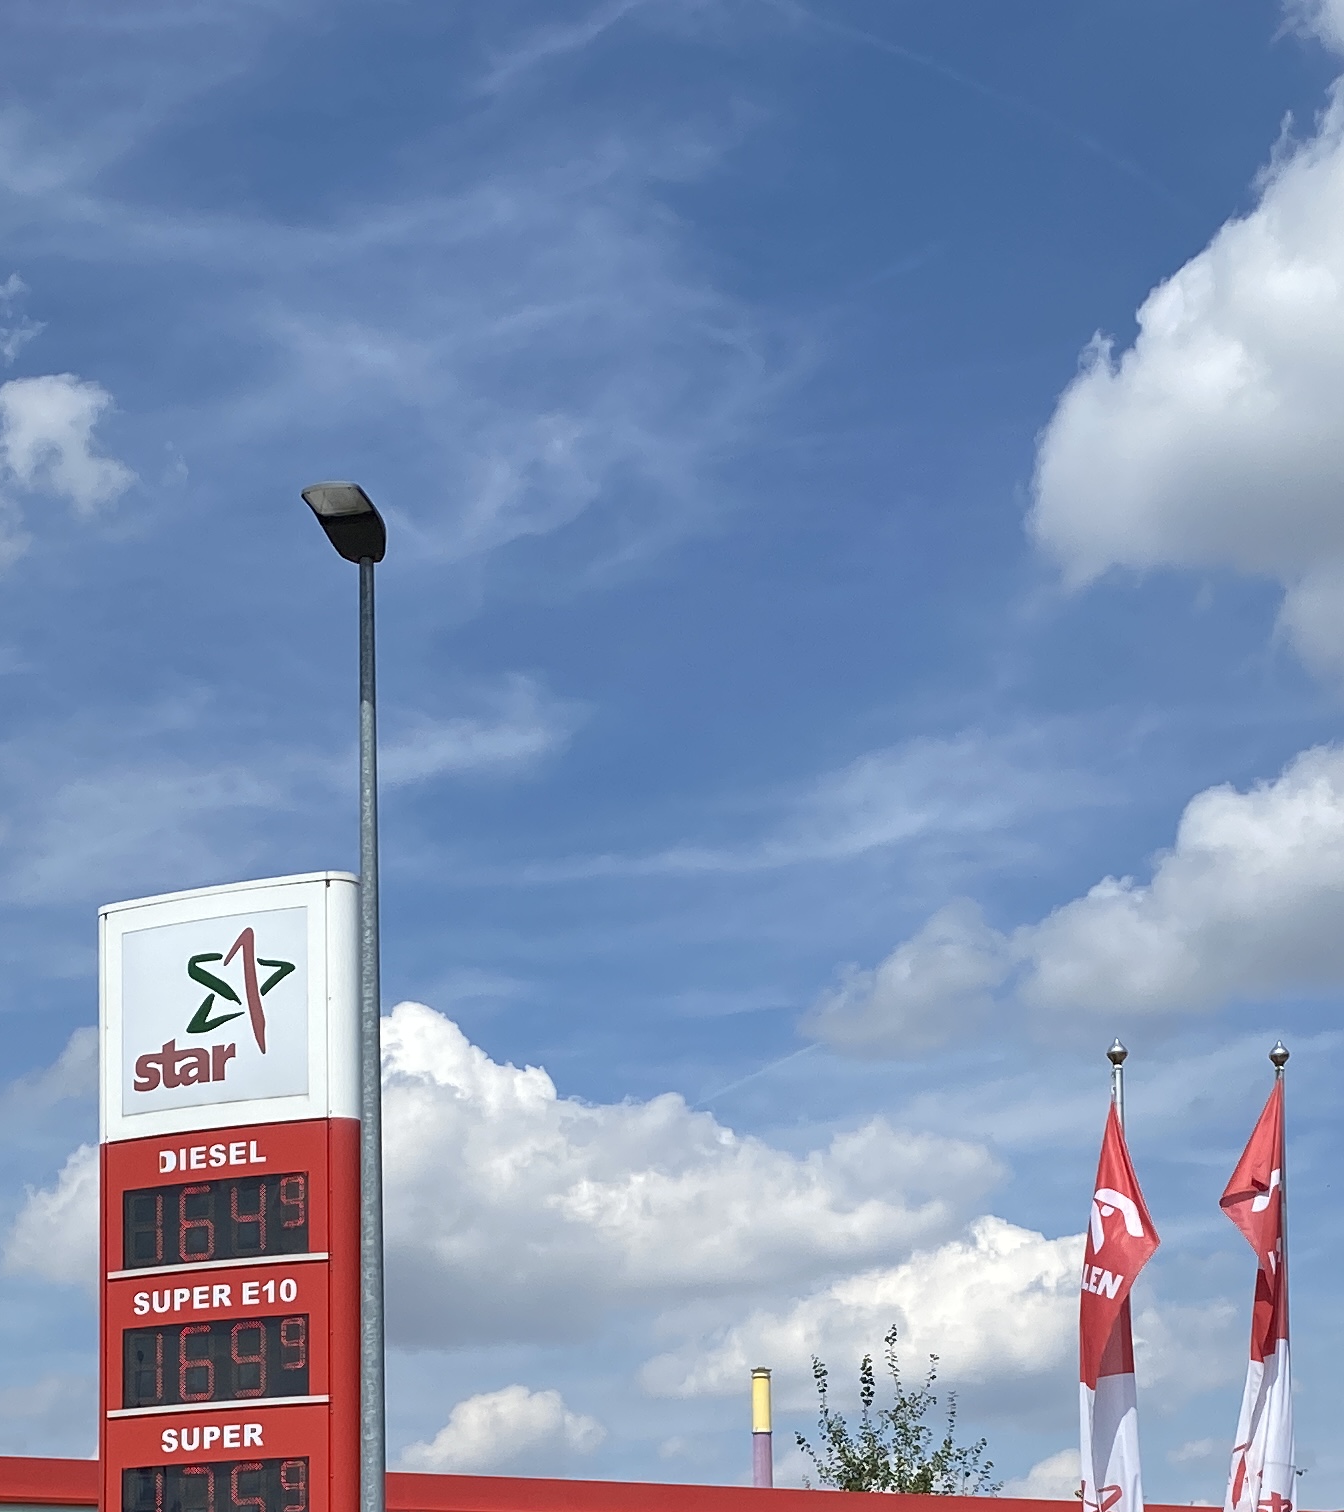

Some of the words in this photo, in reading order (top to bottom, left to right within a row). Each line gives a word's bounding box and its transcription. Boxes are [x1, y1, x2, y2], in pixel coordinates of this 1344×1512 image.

[133, 1038, 236, 1092] star
[159, 1140, 267, 1174] DIESEL
[133, 1283, 232, 1316] SUPER
[242, 1278, 298, 1306] E10
[161, 1423, 265, 1453] SUPER
